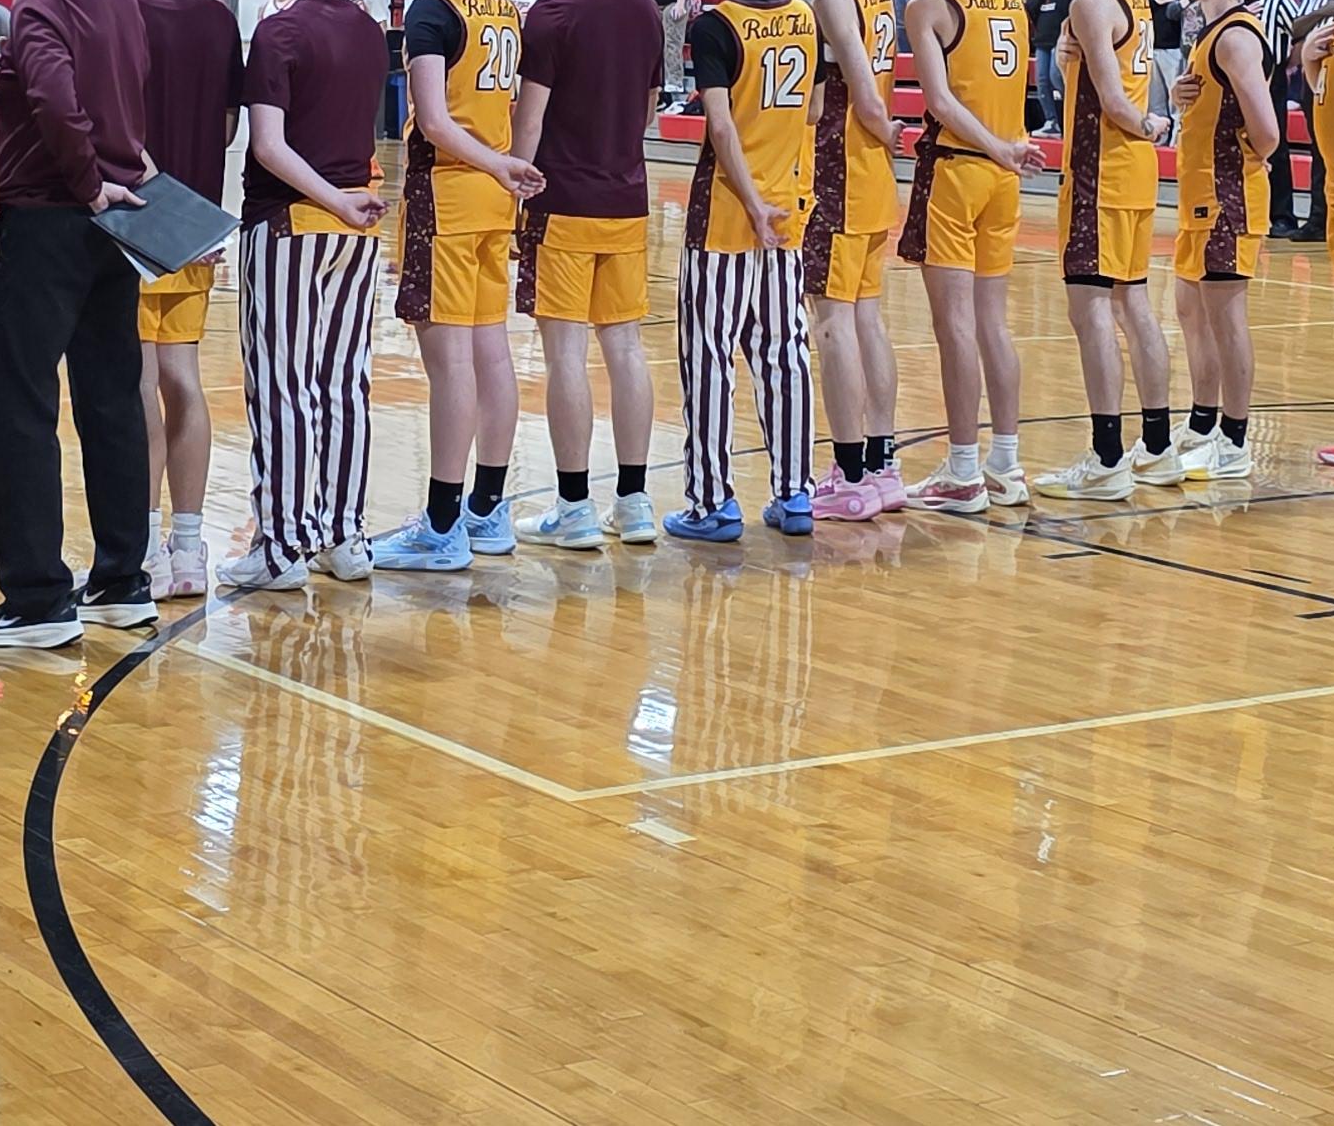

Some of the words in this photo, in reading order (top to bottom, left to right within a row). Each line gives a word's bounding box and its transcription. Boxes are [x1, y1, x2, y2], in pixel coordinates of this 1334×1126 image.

[475, 25, 519, 91] 20
[742, 15, 785, 41] Roll
[786, 14, 815, 36] Tide
[988, 18, 1018, 77] 5
[761, 45, 807, 110] 12
